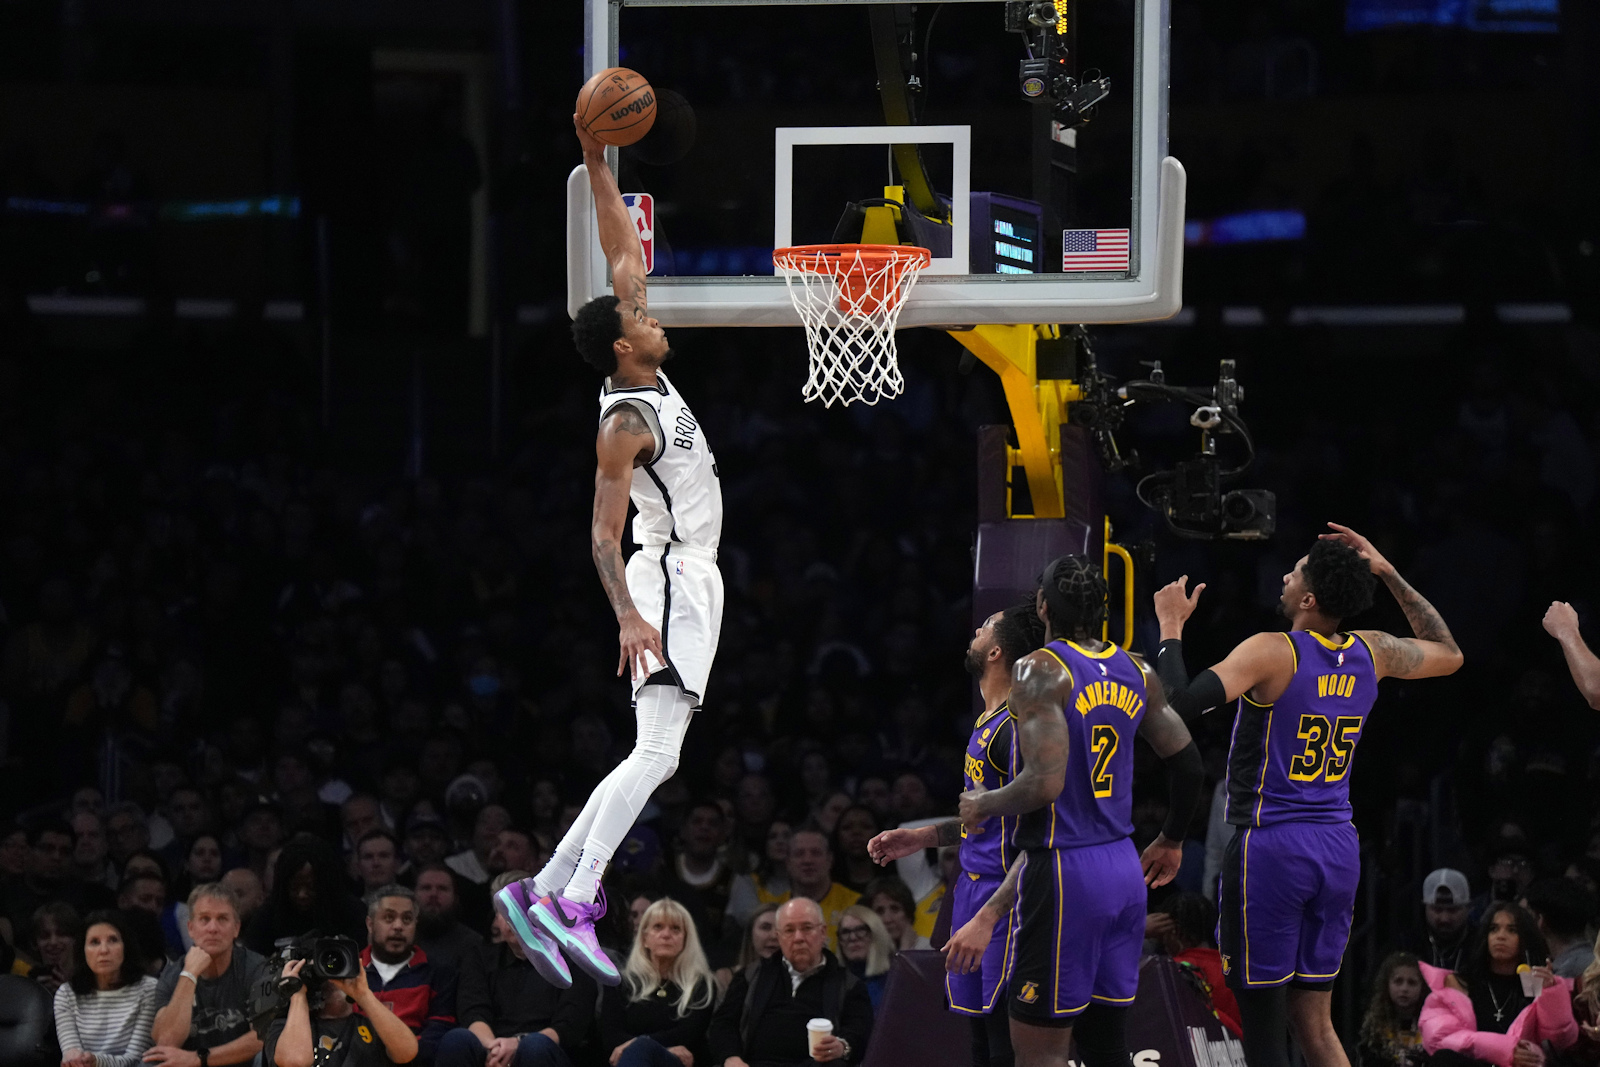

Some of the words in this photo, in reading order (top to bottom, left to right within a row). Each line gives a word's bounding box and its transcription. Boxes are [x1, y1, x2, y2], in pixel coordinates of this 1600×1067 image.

[610, 91, 654, 121] Wilson
[1075, 680, 1143, 719] VANDERBILT
[1317, 673, 1356, 698] WOOD
[1091, 725, 1119, 798] 2
[1288, 714, 1363, 782] 35
[260, 981, 272, 997] 10
